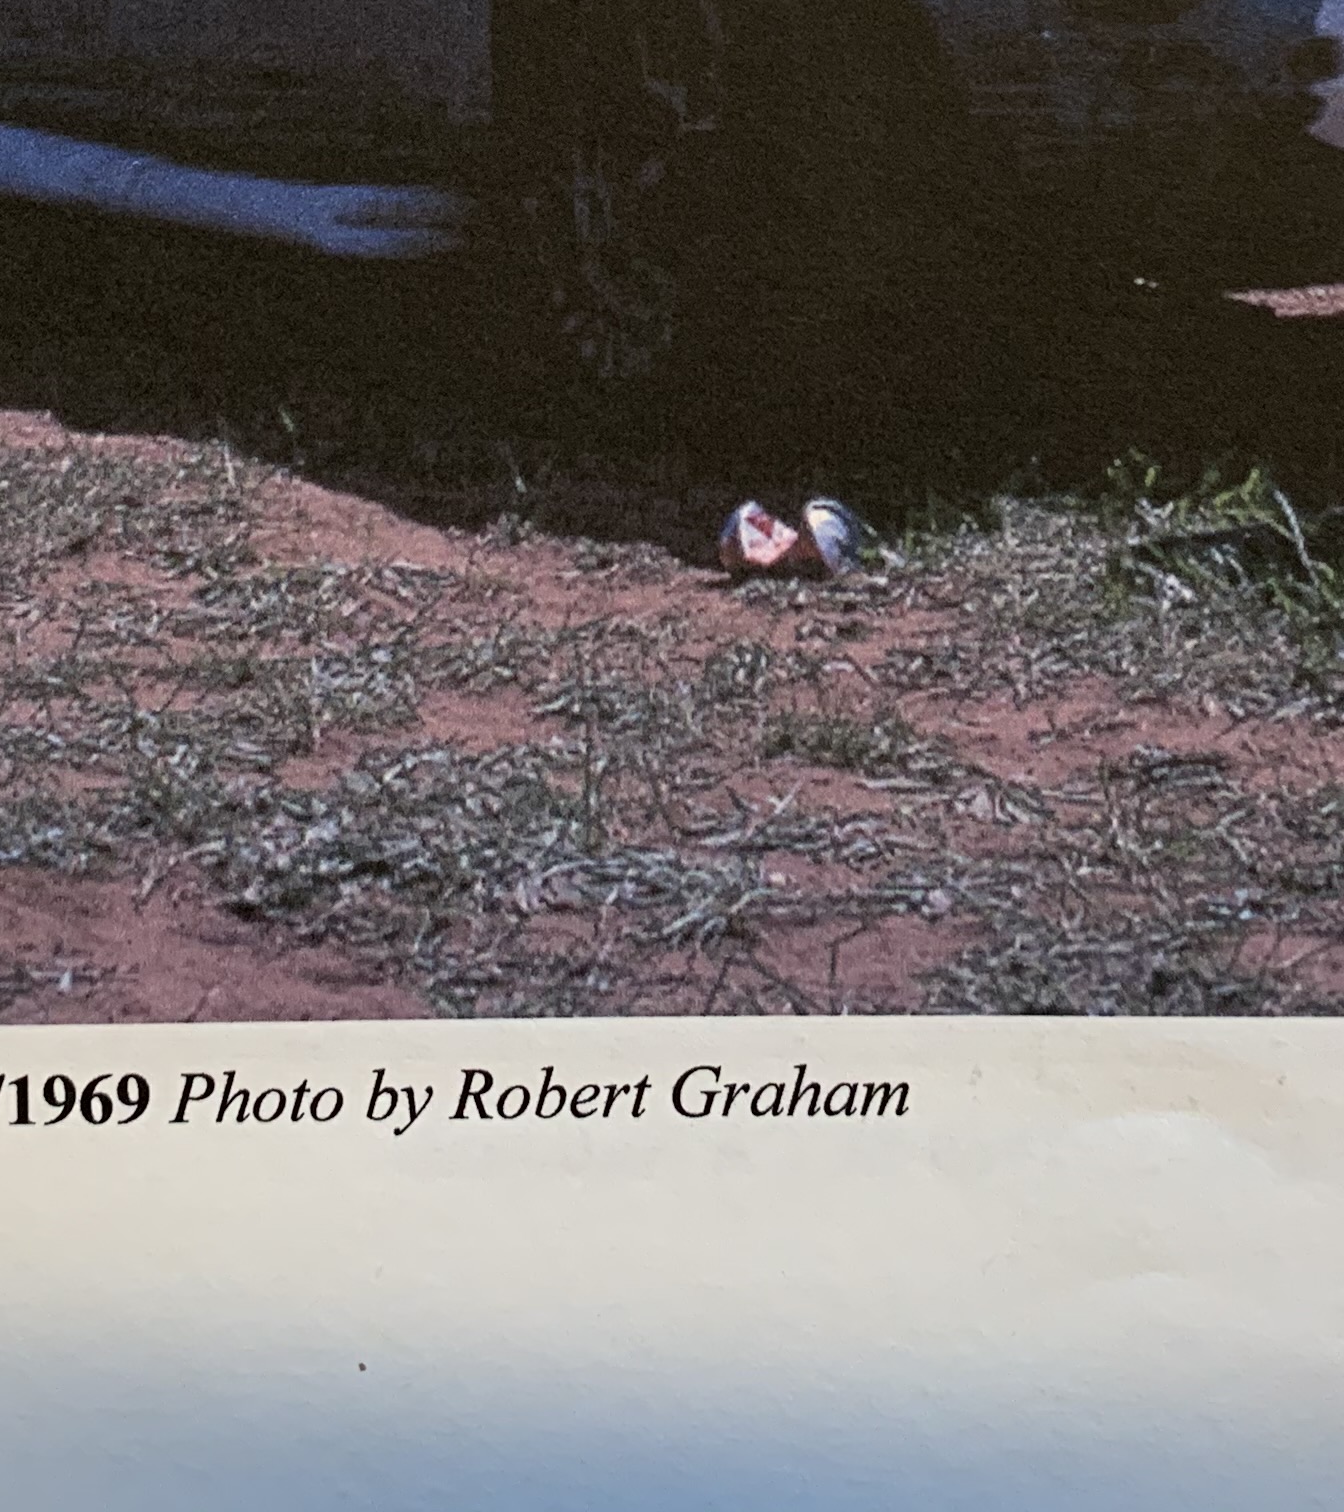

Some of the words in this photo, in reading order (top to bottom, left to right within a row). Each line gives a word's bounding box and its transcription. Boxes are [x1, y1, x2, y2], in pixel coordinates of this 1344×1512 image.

[167, 1069, 345, 1125] Photo
[365, 1067, 435, 1137] by
[447, 1064, 653, 1121] Robert
[670, 1062, 911, 1119] Graham
